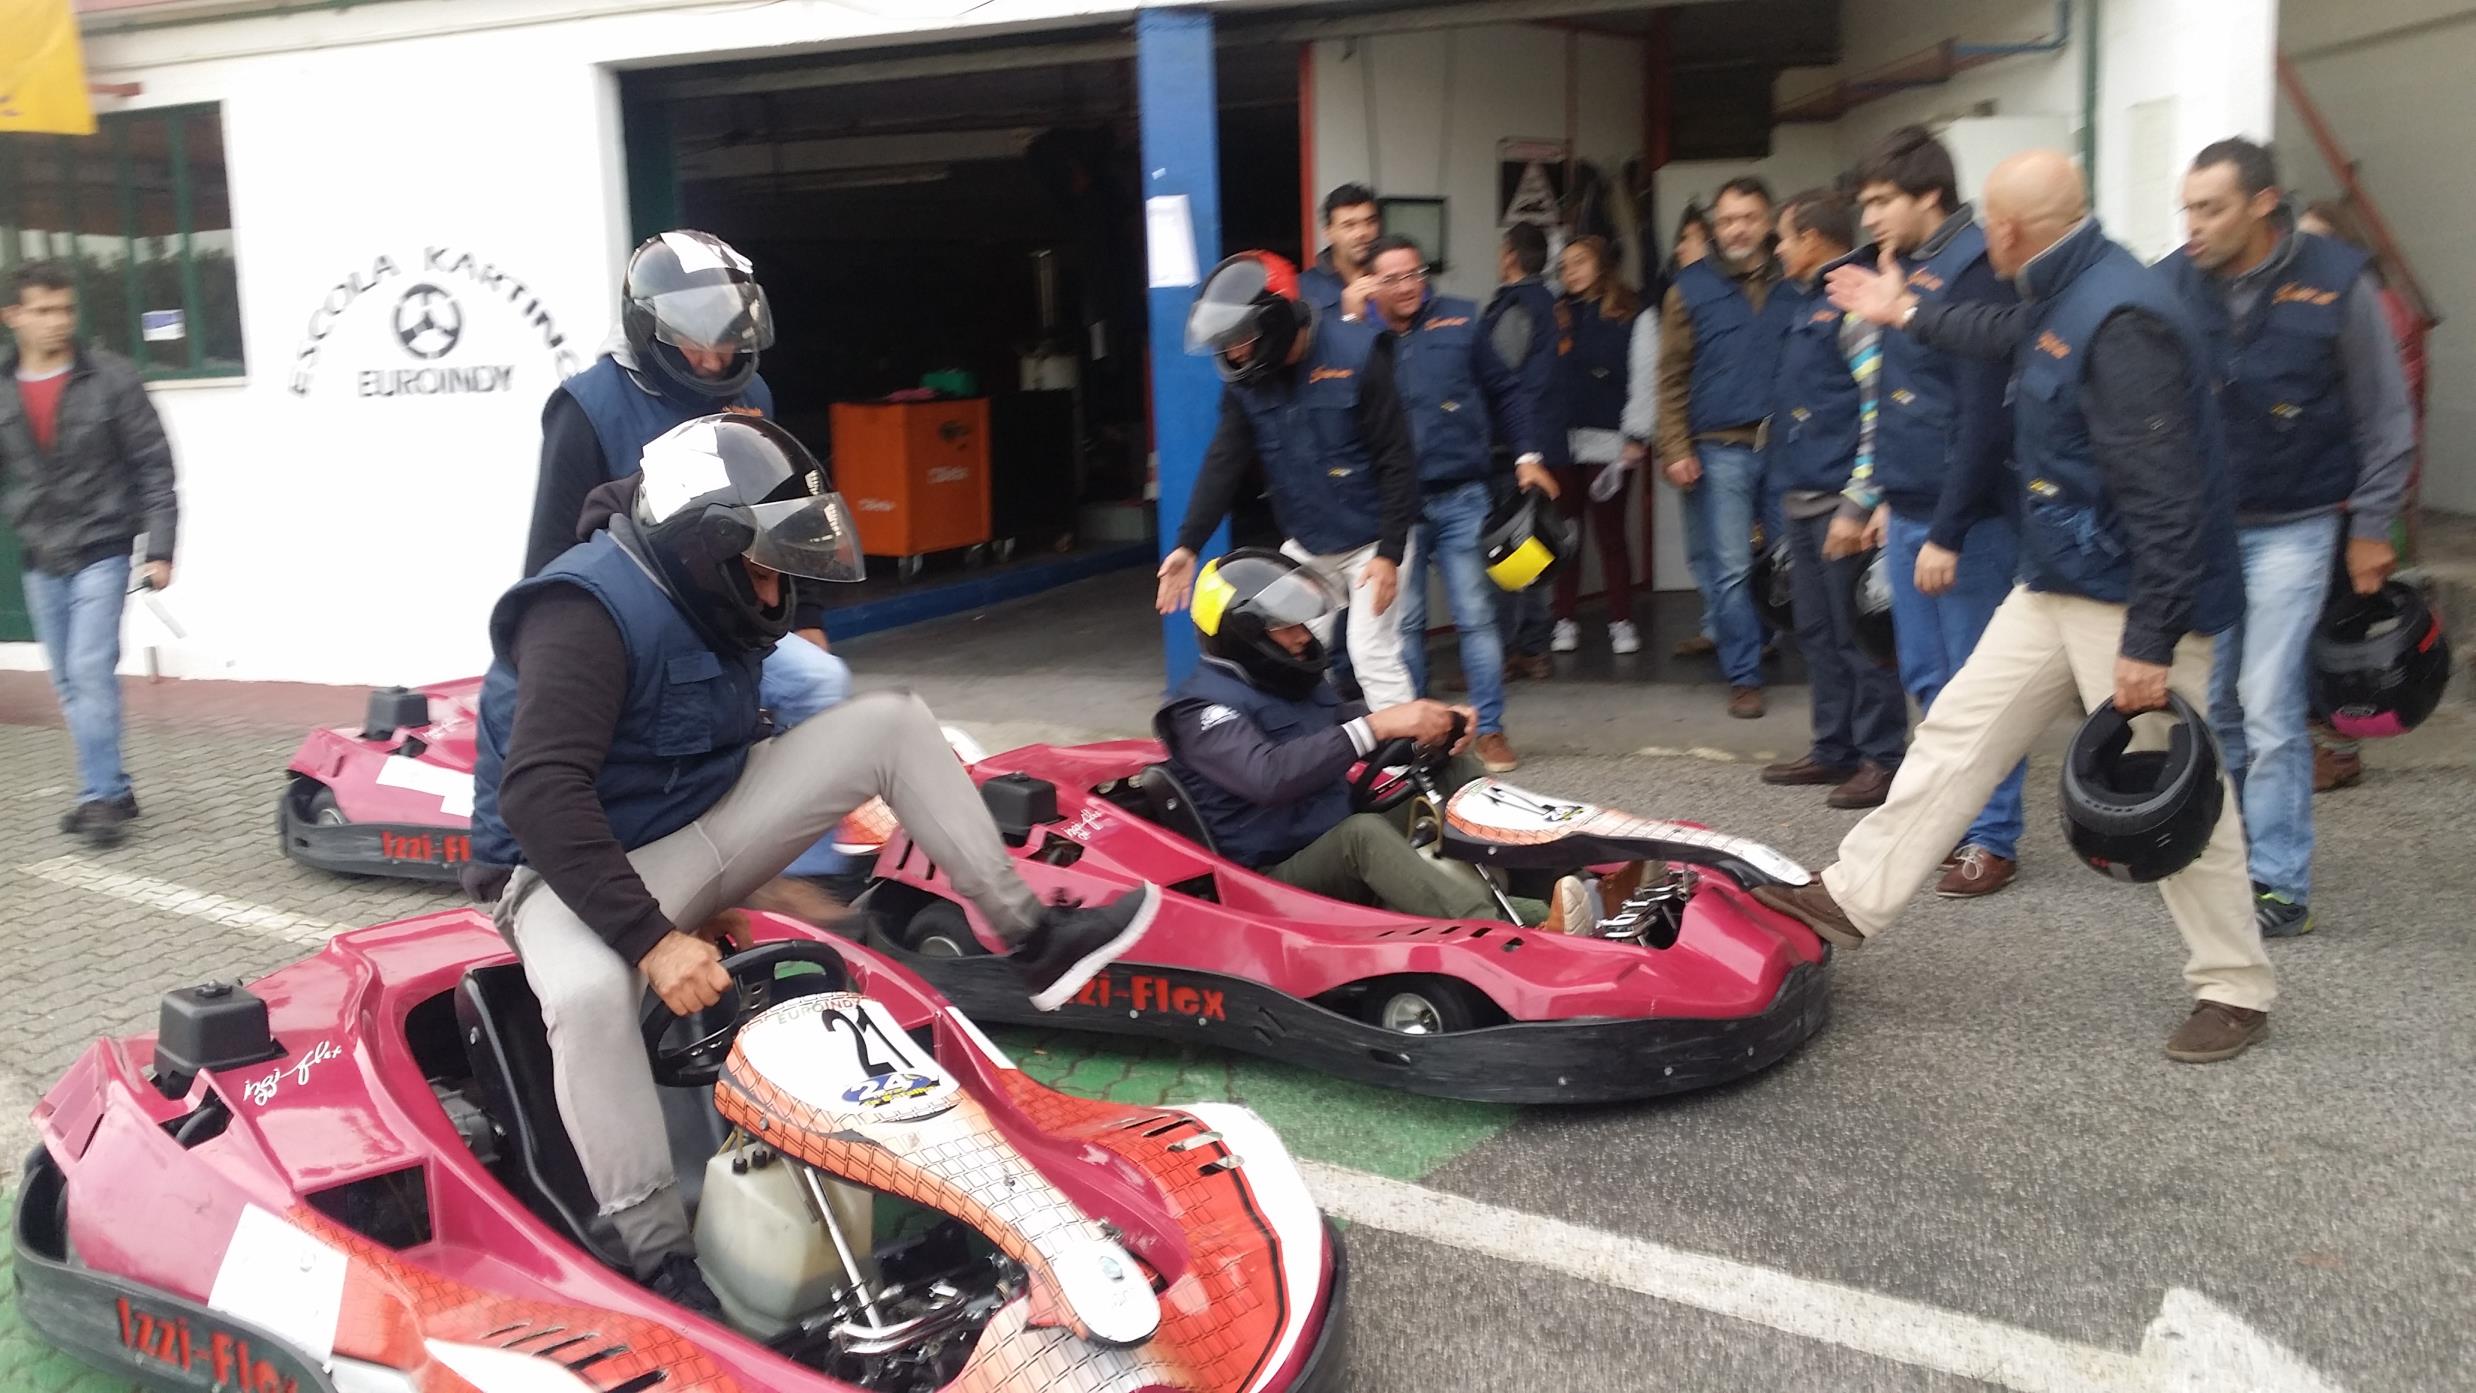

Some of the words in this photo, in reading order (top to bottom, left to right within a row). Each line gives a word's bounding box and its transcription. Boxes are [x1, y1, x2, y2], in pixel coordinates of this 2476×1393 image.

[288, 254, 401, 398] ESCOLA
[357, 365, 516, 398] EUROINDY
[1067, 969, 1226, 1022] zi-Flex
[821, 1005, 915, 1077] 21
